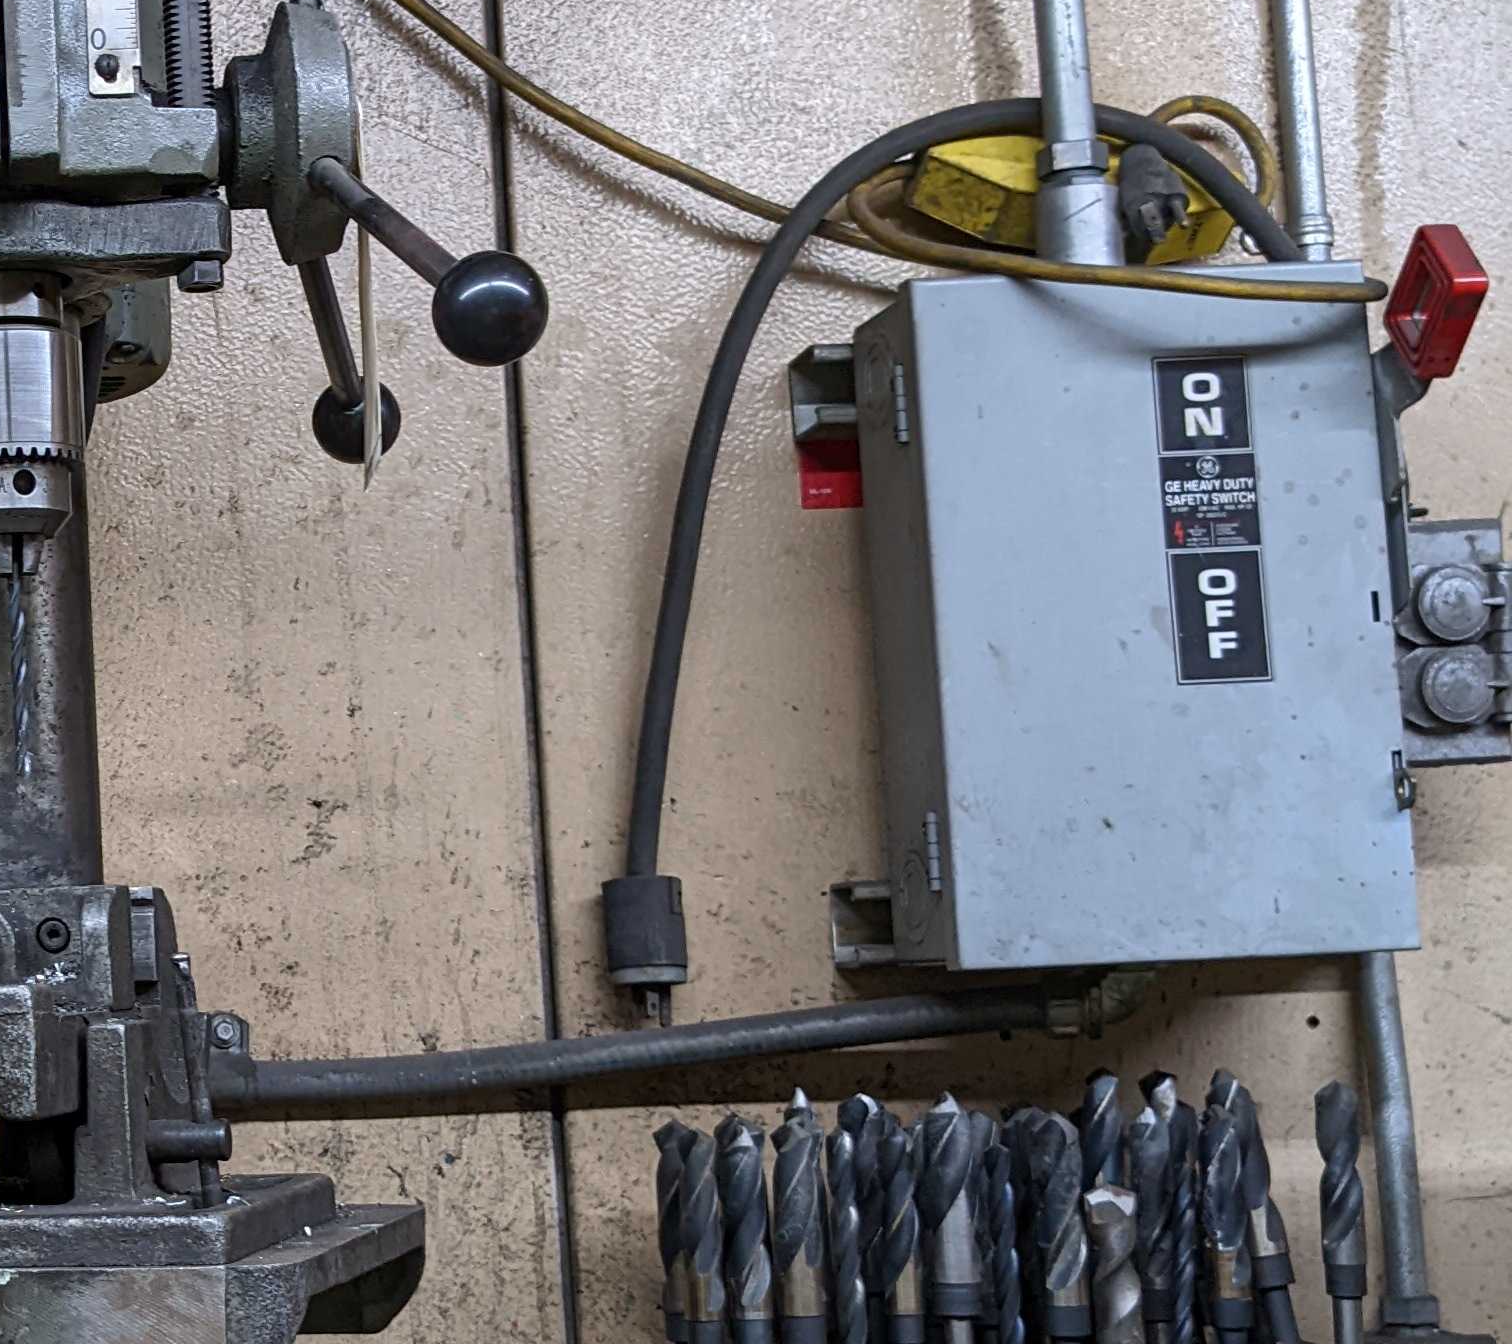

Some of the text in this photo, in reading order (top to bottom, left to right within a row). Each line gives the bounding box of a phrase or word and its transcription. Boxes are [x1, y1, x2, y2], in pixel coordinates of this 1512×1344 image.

[90, 28, 106, 51] 0
[1182, 372, 1225, 437] ON
[1164, 477, 1254, 493] GE HEAVY DUTY
[1165, 491, 1256, 507] SAFETY SWITCH
[1198, 568, 1239, 659] OFF
